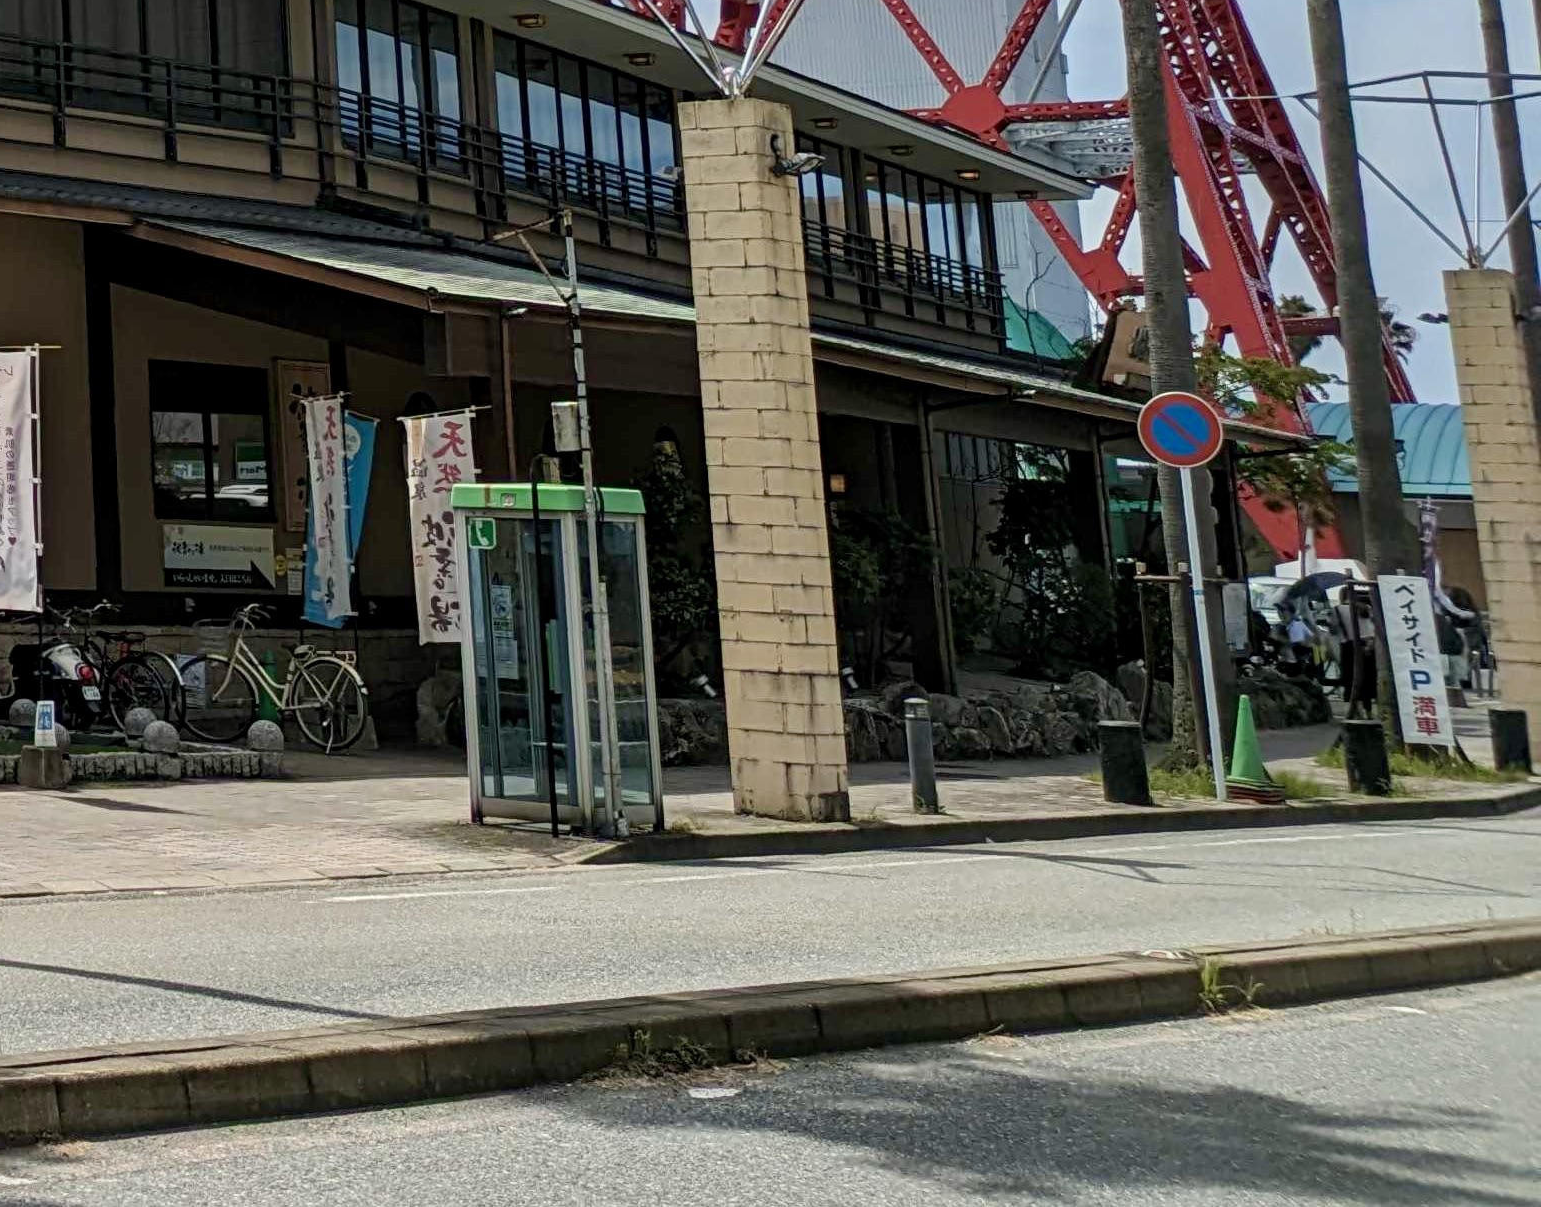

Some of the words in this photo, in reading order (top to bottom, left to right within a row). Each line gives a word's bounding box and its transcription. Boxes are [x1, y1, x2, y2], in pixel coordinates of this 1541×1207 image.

[1394, 583, 1425, 663] ベイサイド
[1409, 669, 1432, 691] P
[1413, 695, 1440, 736] 満車
